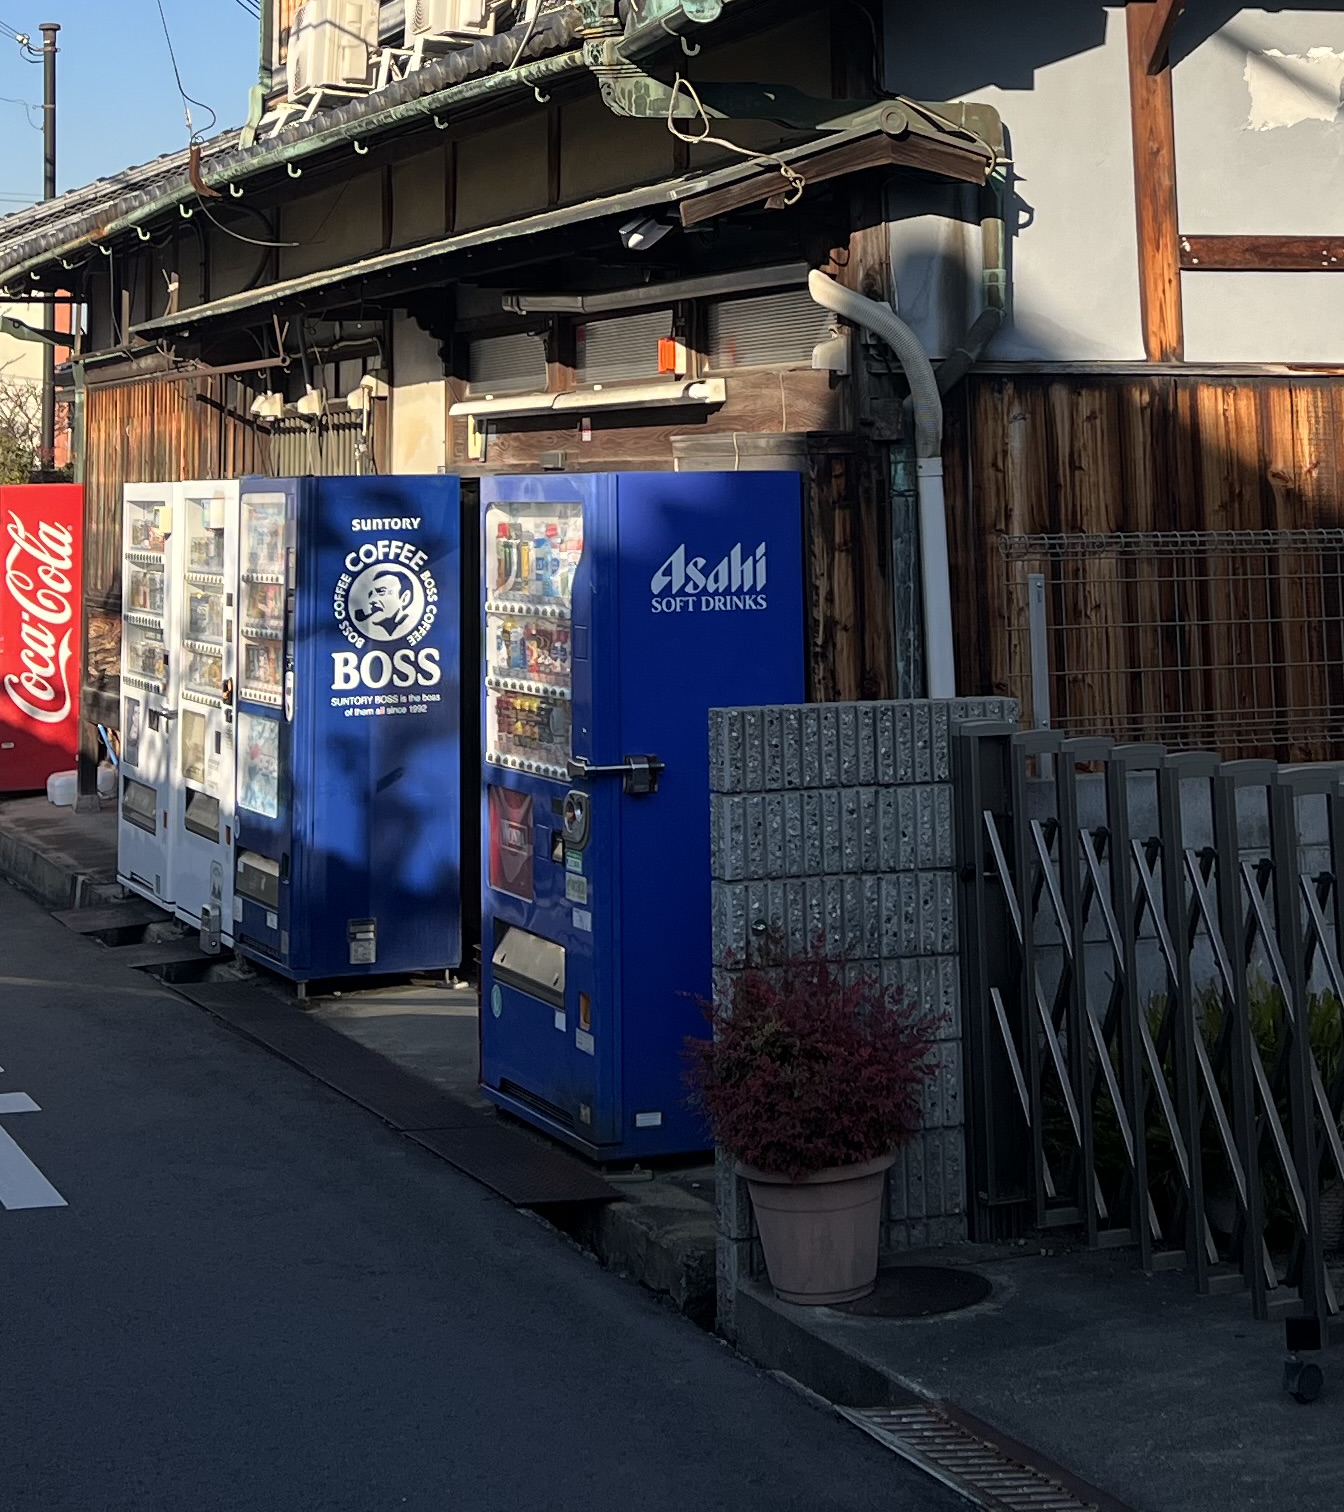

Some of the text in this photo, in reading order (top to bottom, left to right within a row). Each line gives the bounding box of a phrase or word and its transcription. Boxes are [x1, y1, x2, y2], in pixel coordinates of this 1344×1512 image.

[351, 517, 421, 531] SUNTORY
[345, 540, 428, 572] COFFEE
[651, 541, 766, 595] Asahi
[4, 510, 73, 723] Coca-Cola
[333, 573, 365, 649] BOSS COFFEE
[407, 570, 438, 646] BOSS COFFEE
[651, 594, 767, 613] SOFT DRINKS
[331, 647, 441, 690] BOSS
[331, 695, 373, 706] SUNTORY
[375, 694, 398, 704] BOSS
